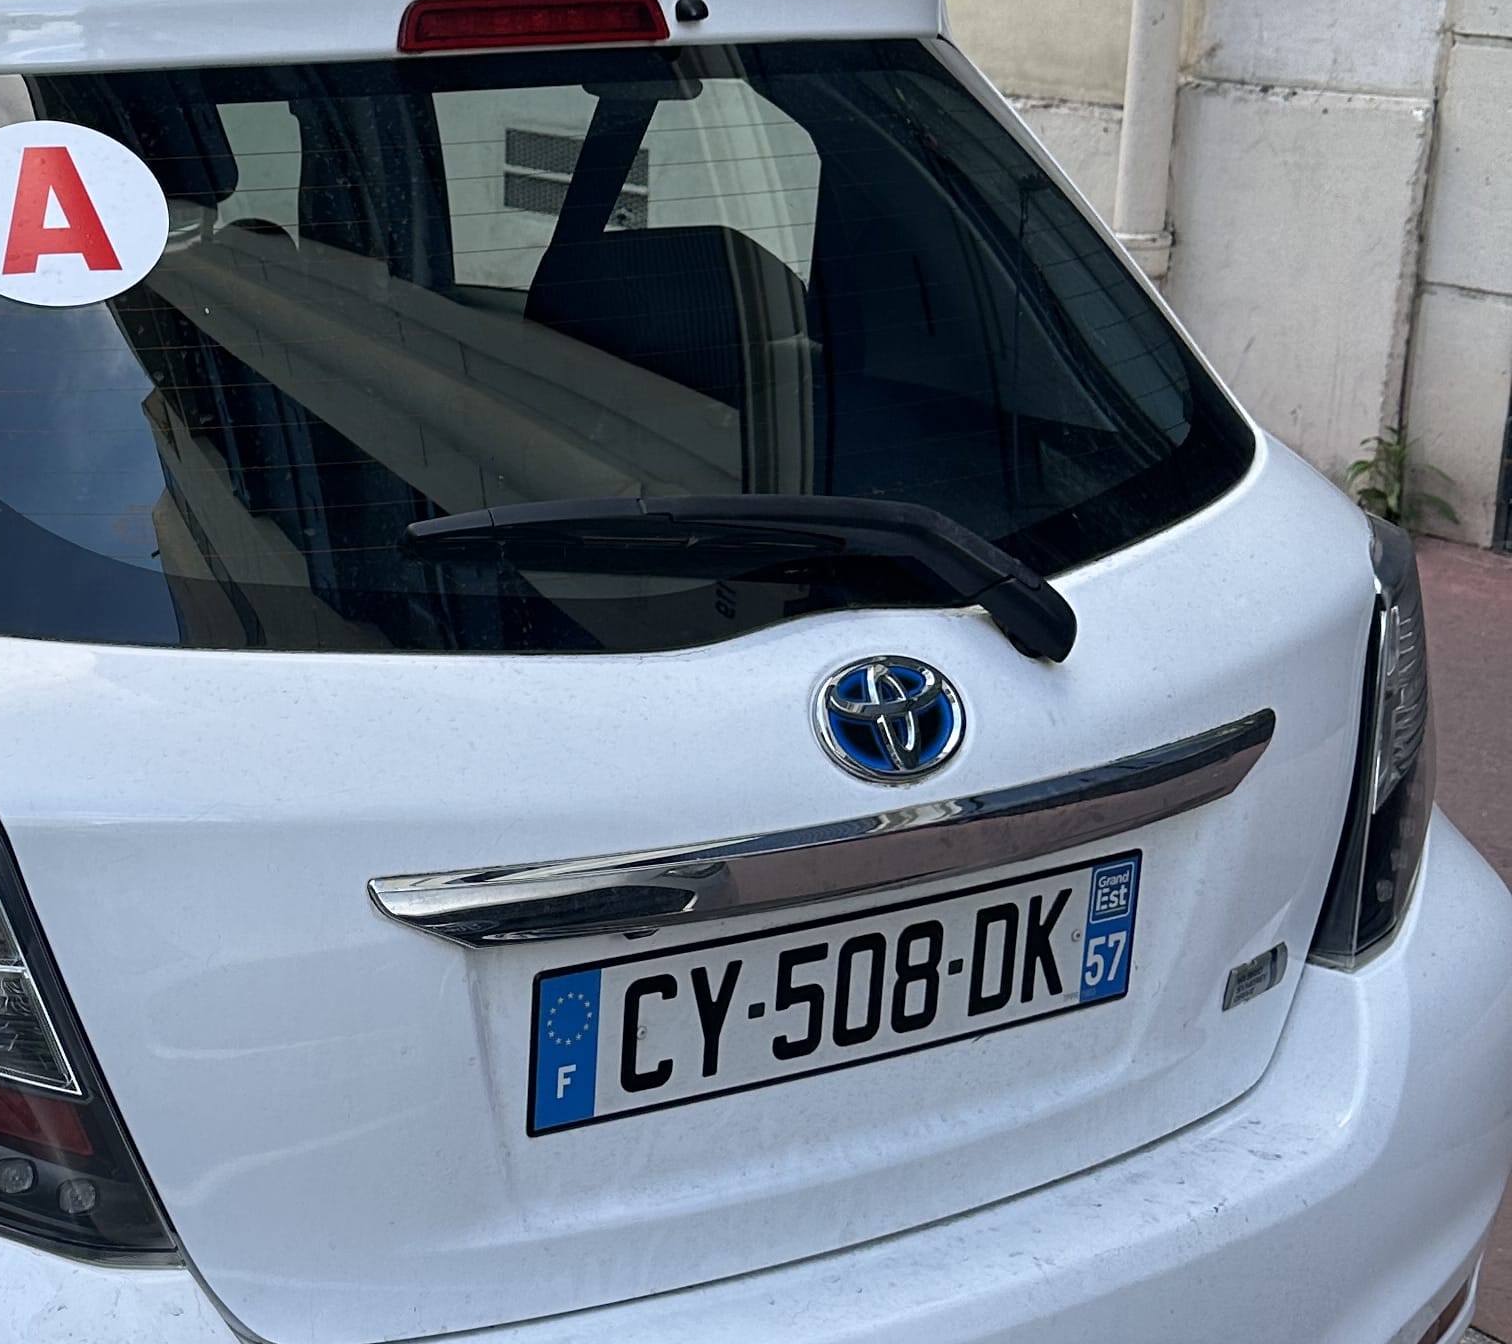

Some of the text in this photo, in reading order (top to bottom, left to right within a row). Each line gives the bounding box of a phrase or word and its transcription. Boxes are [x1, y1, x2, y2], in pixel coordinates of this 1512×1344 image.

[1, 146, 123, 275] A
[1095, 885, 1128, 911] Est
[1098, 870, 1130, 888] Grand
[1084, 931, 1127, 986] 57
[620, 887, 1074, 1093] CY-508-DK
[556, 1064, 577, 1099] F
